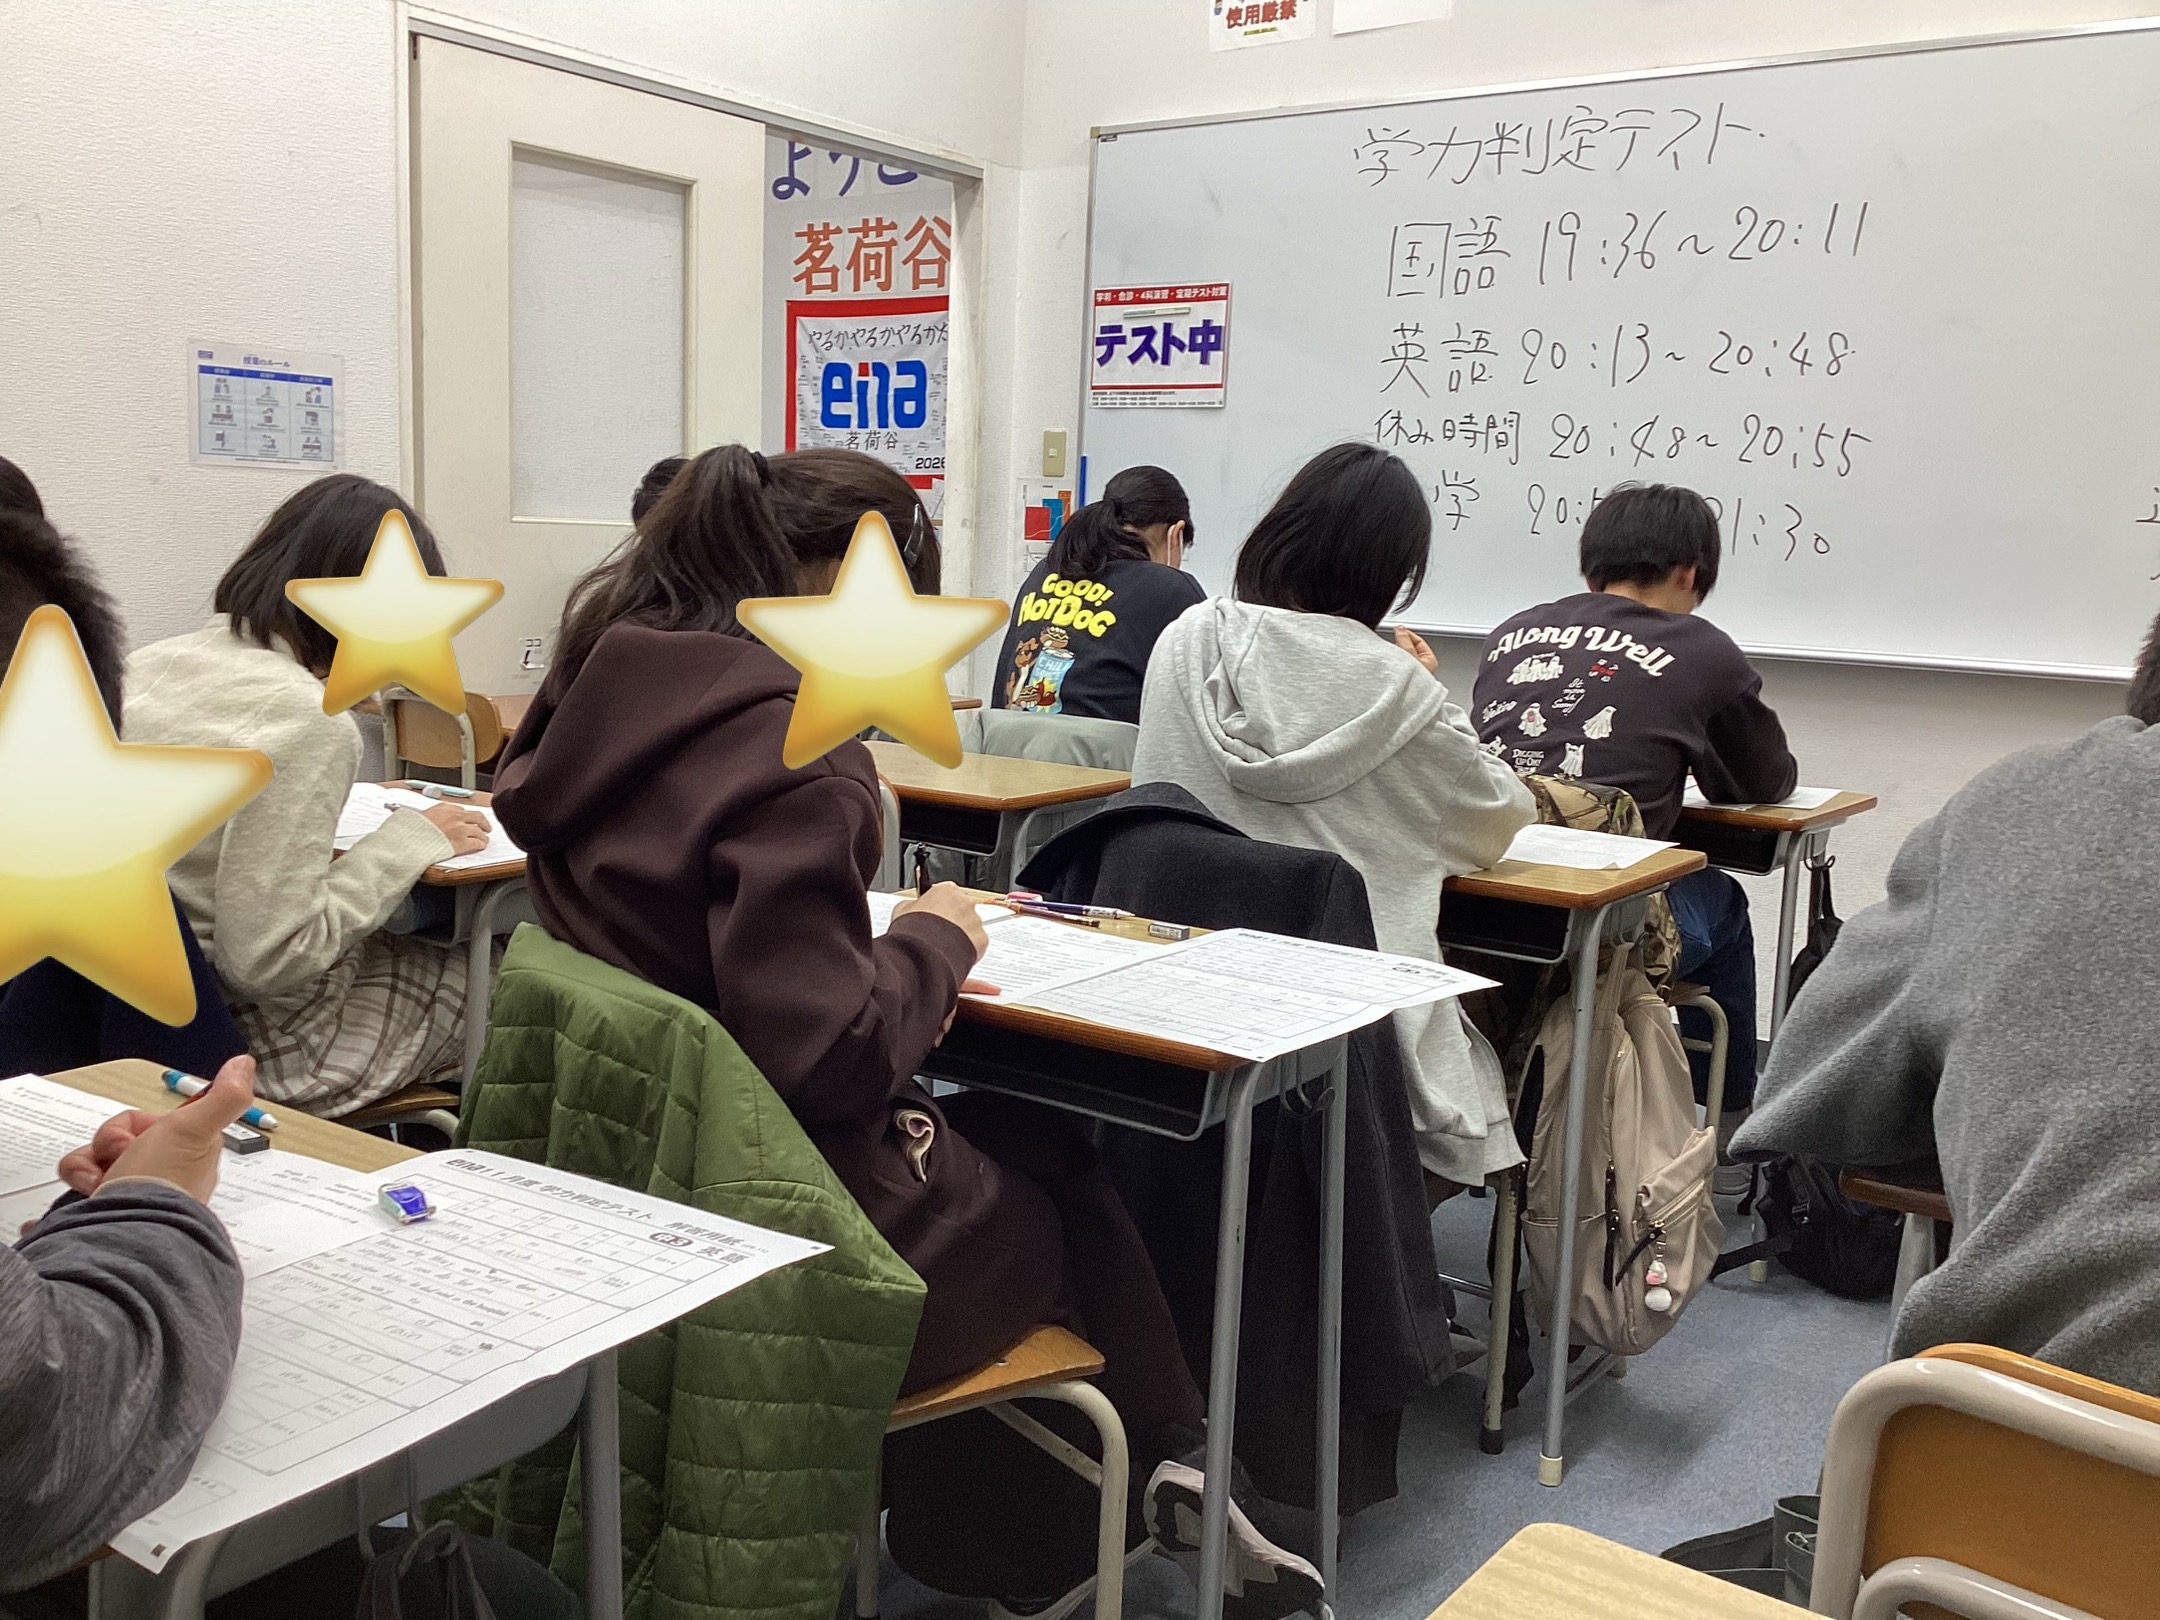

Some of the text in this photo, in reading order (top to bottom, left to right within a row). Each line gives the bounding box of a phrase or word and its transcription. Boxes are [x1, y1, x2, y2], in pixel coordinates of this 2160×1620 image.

[793, 214, 952, 295] 茗荷谷
[1387, 215, 1511, 299] 国語
[1095, 319, 1224, 368] テスト中
[1380, 322, 1499, 399] 英語
[844, 430, 899, 451] 茗荷谷
[1374, 408, 1521, 466] 休み時間
[1487, 626, 1676, 677] Along Well
